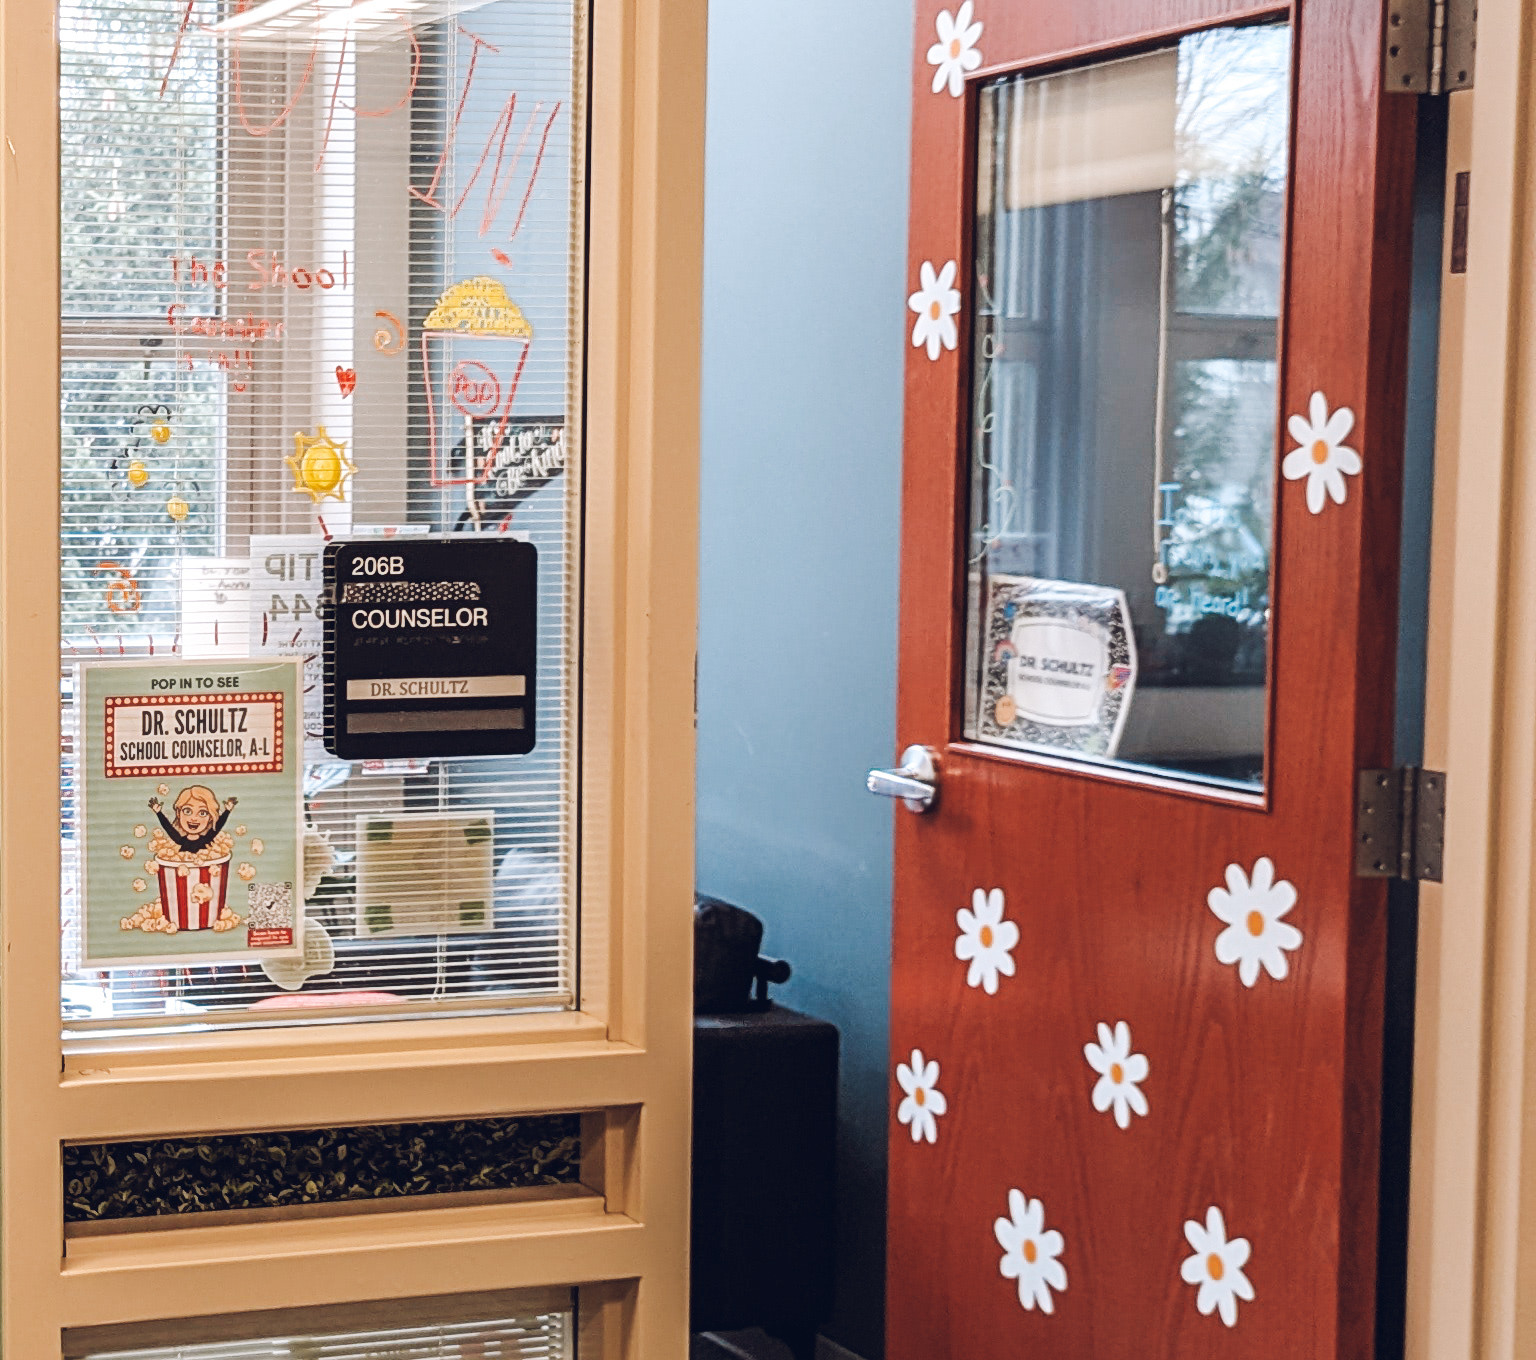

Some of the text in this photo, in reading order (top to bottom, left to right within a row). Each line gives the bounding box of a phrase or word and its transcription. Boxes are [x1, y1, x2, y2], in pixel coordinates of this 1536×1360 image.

[351, 555, 405, 576] 206B
[351, 607, 489, 629] COUNSELOR
[151, 676, 240, 690] POP IN TO SEE
[370, 680, 470, 697] DR. SCHULTZ
[141, 707, 248, 736] DR. SCHULTZ
[120, 737, 270, 761] SCHOOL COUNSELOR, A-L
